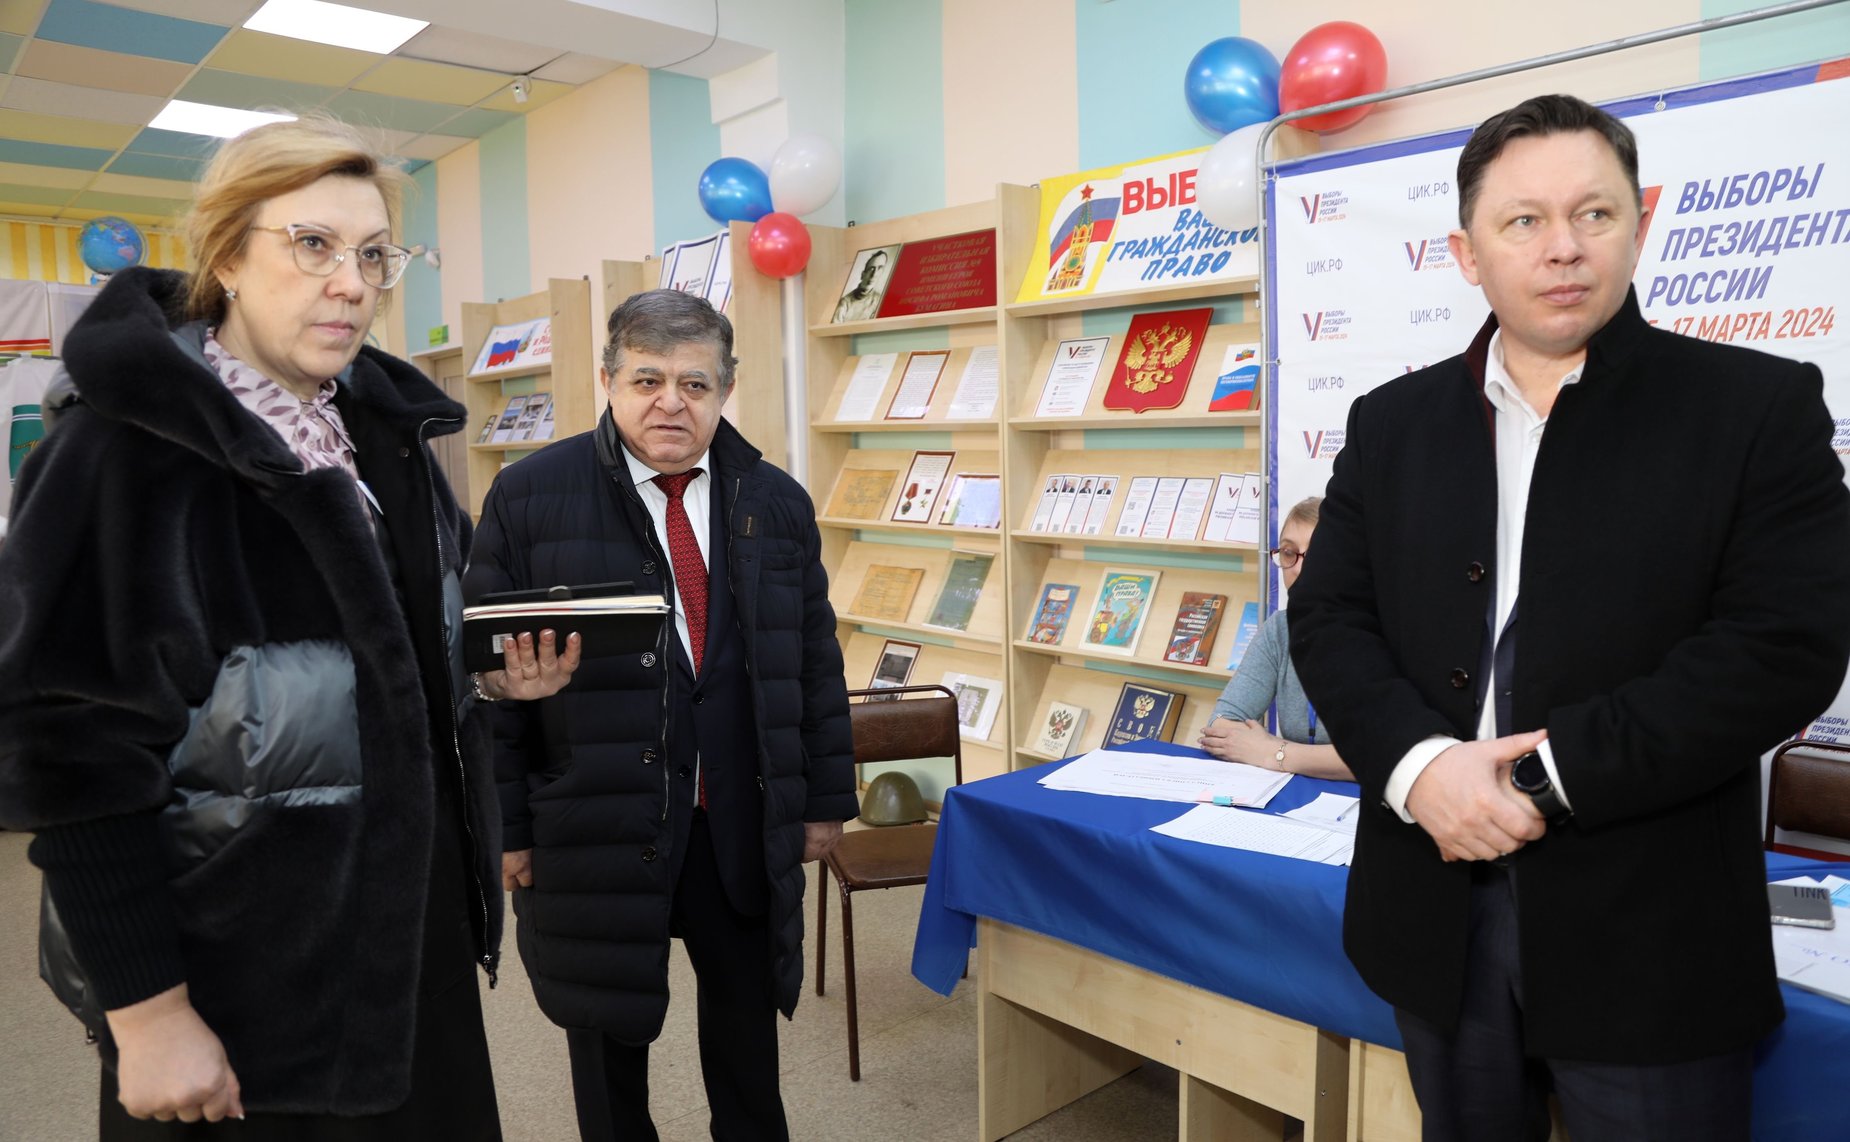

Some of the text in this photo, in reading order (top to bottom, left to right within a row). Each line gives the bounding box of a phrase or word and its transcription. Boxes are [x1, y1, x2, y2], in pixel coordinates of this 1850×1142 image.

[1121, 168, 1199, 216] ВЫБ
[1408, 181, 1450, 202] ЦИК.РФ
[1675, 162, 1825, 215] ВЫБОРЫ
[1322, 191, 1342, 199] ВЫБОРЫ
[1320, 197, 1349, 207] ПРЕЗИДЕНТА
[1319, 207, 1337, 216] РОССИИ
[1173, 208, 1214, 233] ВАШ
[1106, 224, 1260, 263] ГРАЖДАНСКО
[1429, 236, 1448, 246] ВЫБОР
[1427, 245, 1449, 254] ПРЕЗИД
[1425, 254, 1446, 263] РОССИИ
[1140, 250, 1233, 281] ПРАВО
[1306, 258, 1343, 276] ЦИК.РФ
[1645, 265, 1774, 308] РОССИИ
[1325, 310, 1346, 318] ВЫБОРЫ
[1410, 307, 1452, 326] ЦИК.РФ
[1323, 317, 1351, 326] ПРЕЗИДЕНТА
[1695, 311, 1772, 344] МАРТА
[1774, 306, 1835, 339] 2024
[1321, 326, 1339, 334] РОССИИ
[1308, 376, 1344, 392] ЦИК.РФ
[1320, 445, 1339, 453] РОССИИ
[1815, 716, 1849, 726] ВЫБОРЫ
[1811, 724, 1850, 737] ПРЕЗИДЕН
[1807, 734, 1838, 743] РОССИИ
